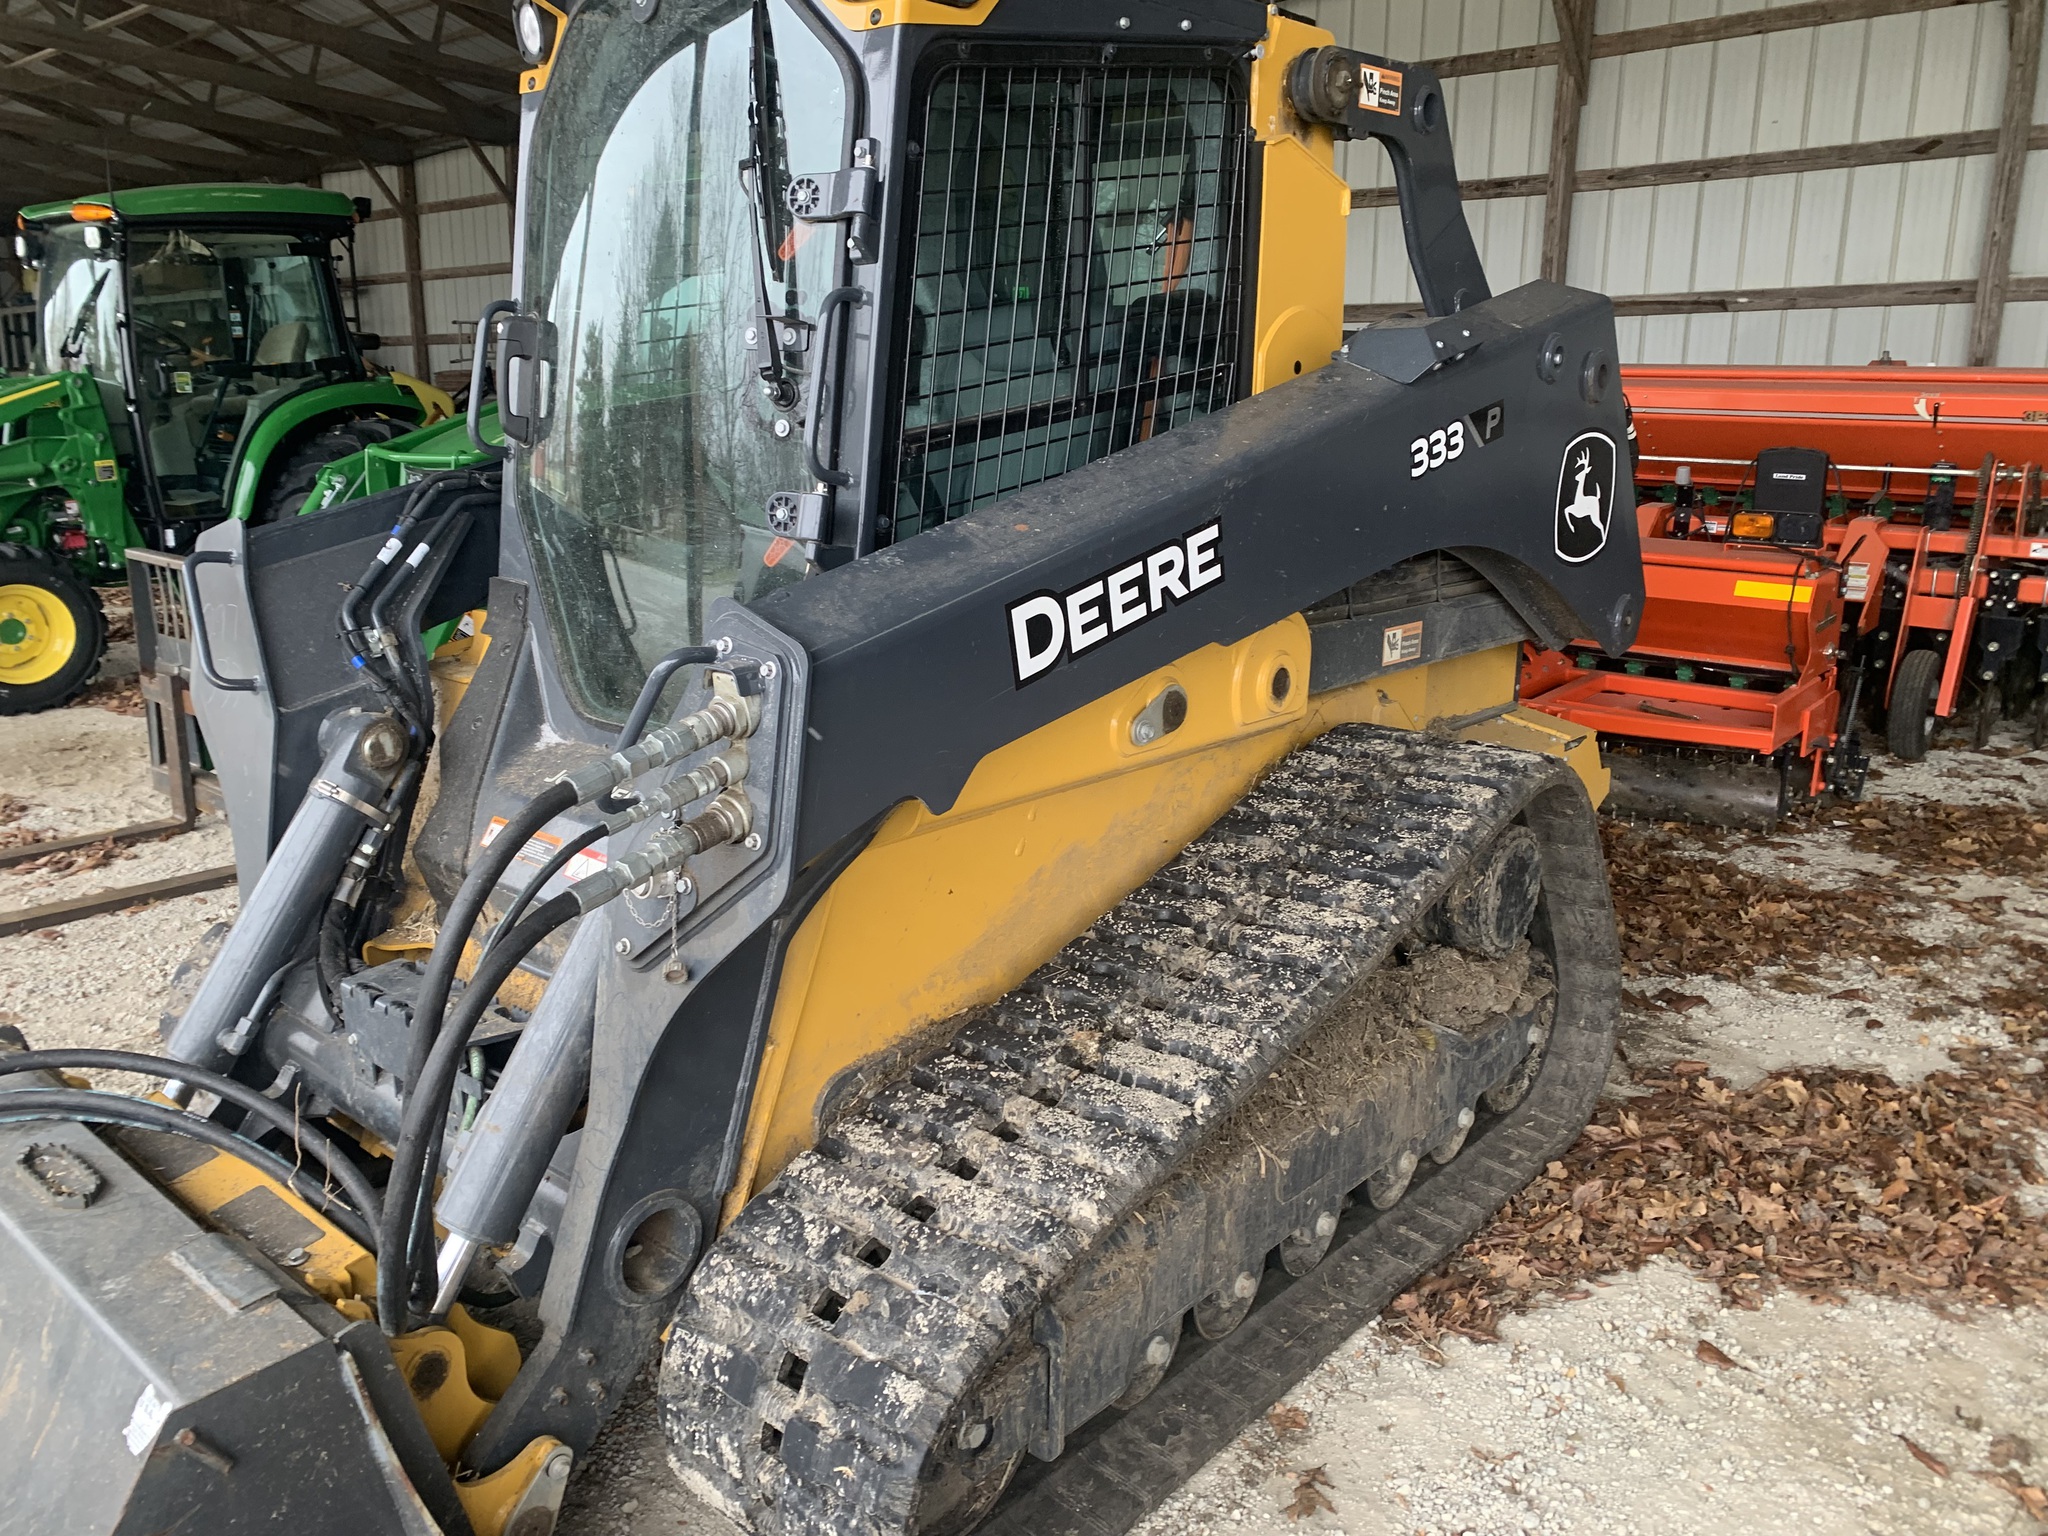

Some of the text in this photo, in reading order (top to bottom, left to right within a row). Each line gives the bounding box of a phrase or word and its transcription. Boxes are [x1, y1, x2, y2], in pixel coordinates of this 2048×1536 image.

[1410, 406, 1502, 478] 333 P
[1010, 523, 1222, 682] DEERE
